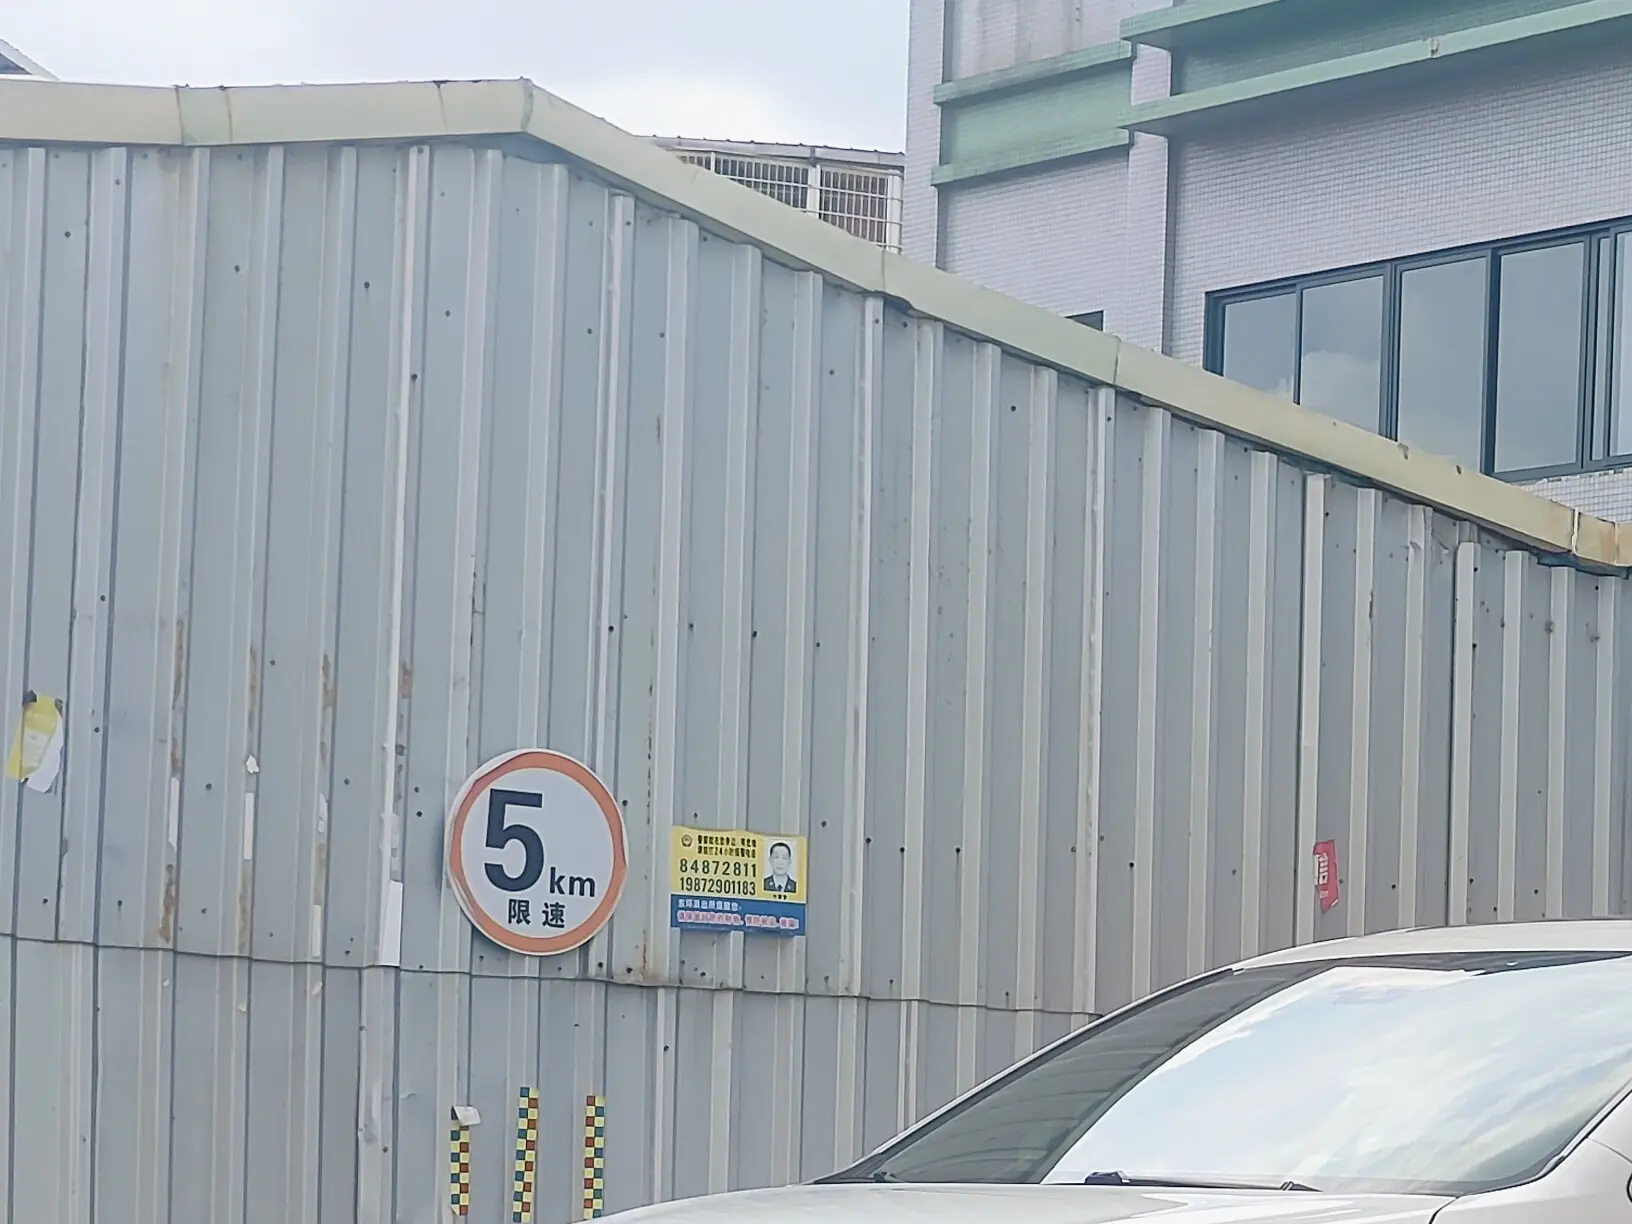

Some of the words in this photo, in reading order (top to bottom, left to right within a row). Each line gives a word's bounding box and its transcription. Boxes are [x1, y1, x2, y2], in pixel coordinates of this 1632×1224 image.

[679, 858, 757, 878] 84872811
[679, 877, 757, 896] 19872901183
[507, 899, 566, 929] 限速
